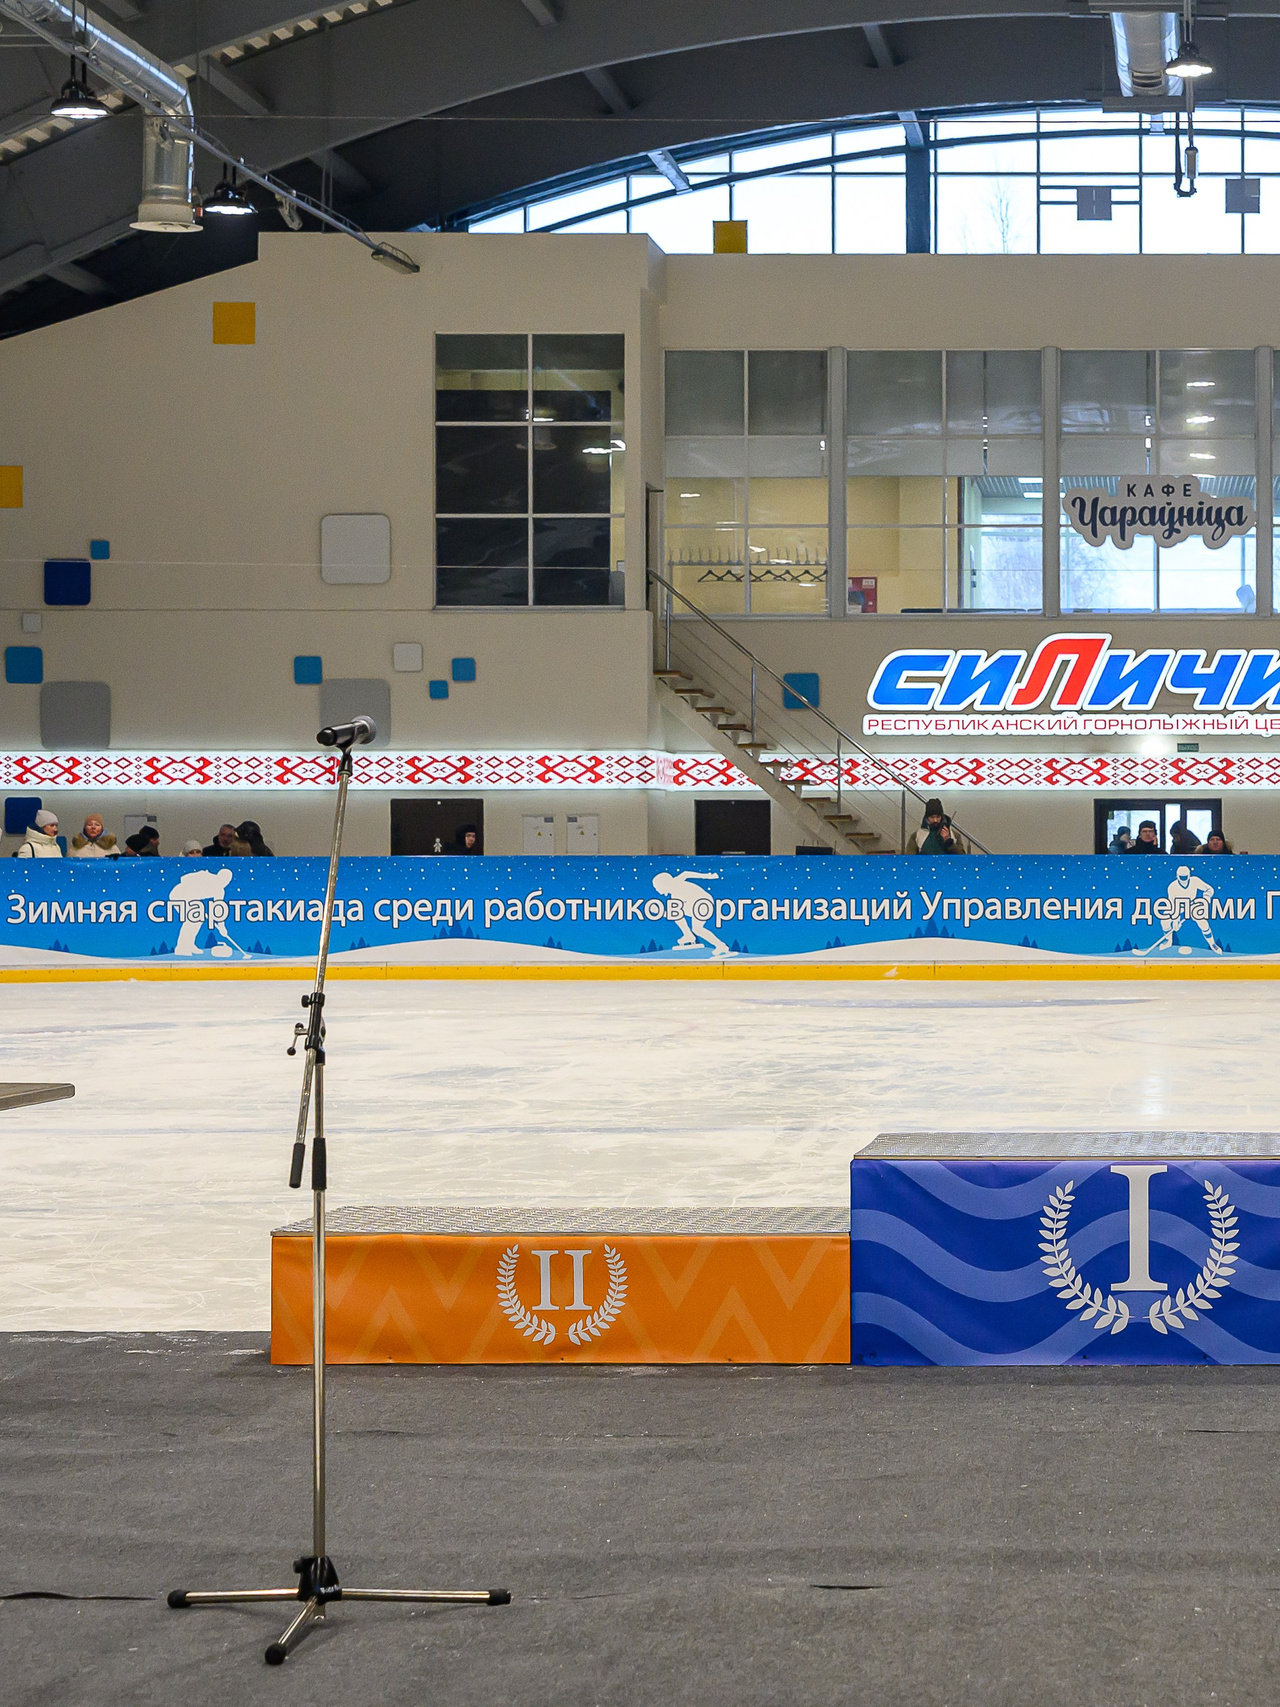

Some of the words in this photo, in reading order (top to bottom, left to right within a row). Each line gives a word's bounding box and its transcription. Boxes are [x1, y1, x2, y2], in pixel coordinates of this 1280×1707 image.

[1126, 483, 1192, 498] КАФЕ
[1071, 496, 1248, 541] Чараўніца
[867, 715, 1078, 731] РЕСПУБЛИКАНСКИЙ
[1083, 715, 1249, 731] ГОРНОЛЫЖНЫЙ
[7, 893, 137, 924] Зимняя
[147, 899, 364, 928] спартакиада
[373, 898, 475, 928] среди
[484, 890, 686, 928] работников
[692, 890, 912, 926] организаций
[920, 890, 1123, 927] Управления
[1131, 898, 1256, 926] делами
[531, 1249, 592, 1311] II
